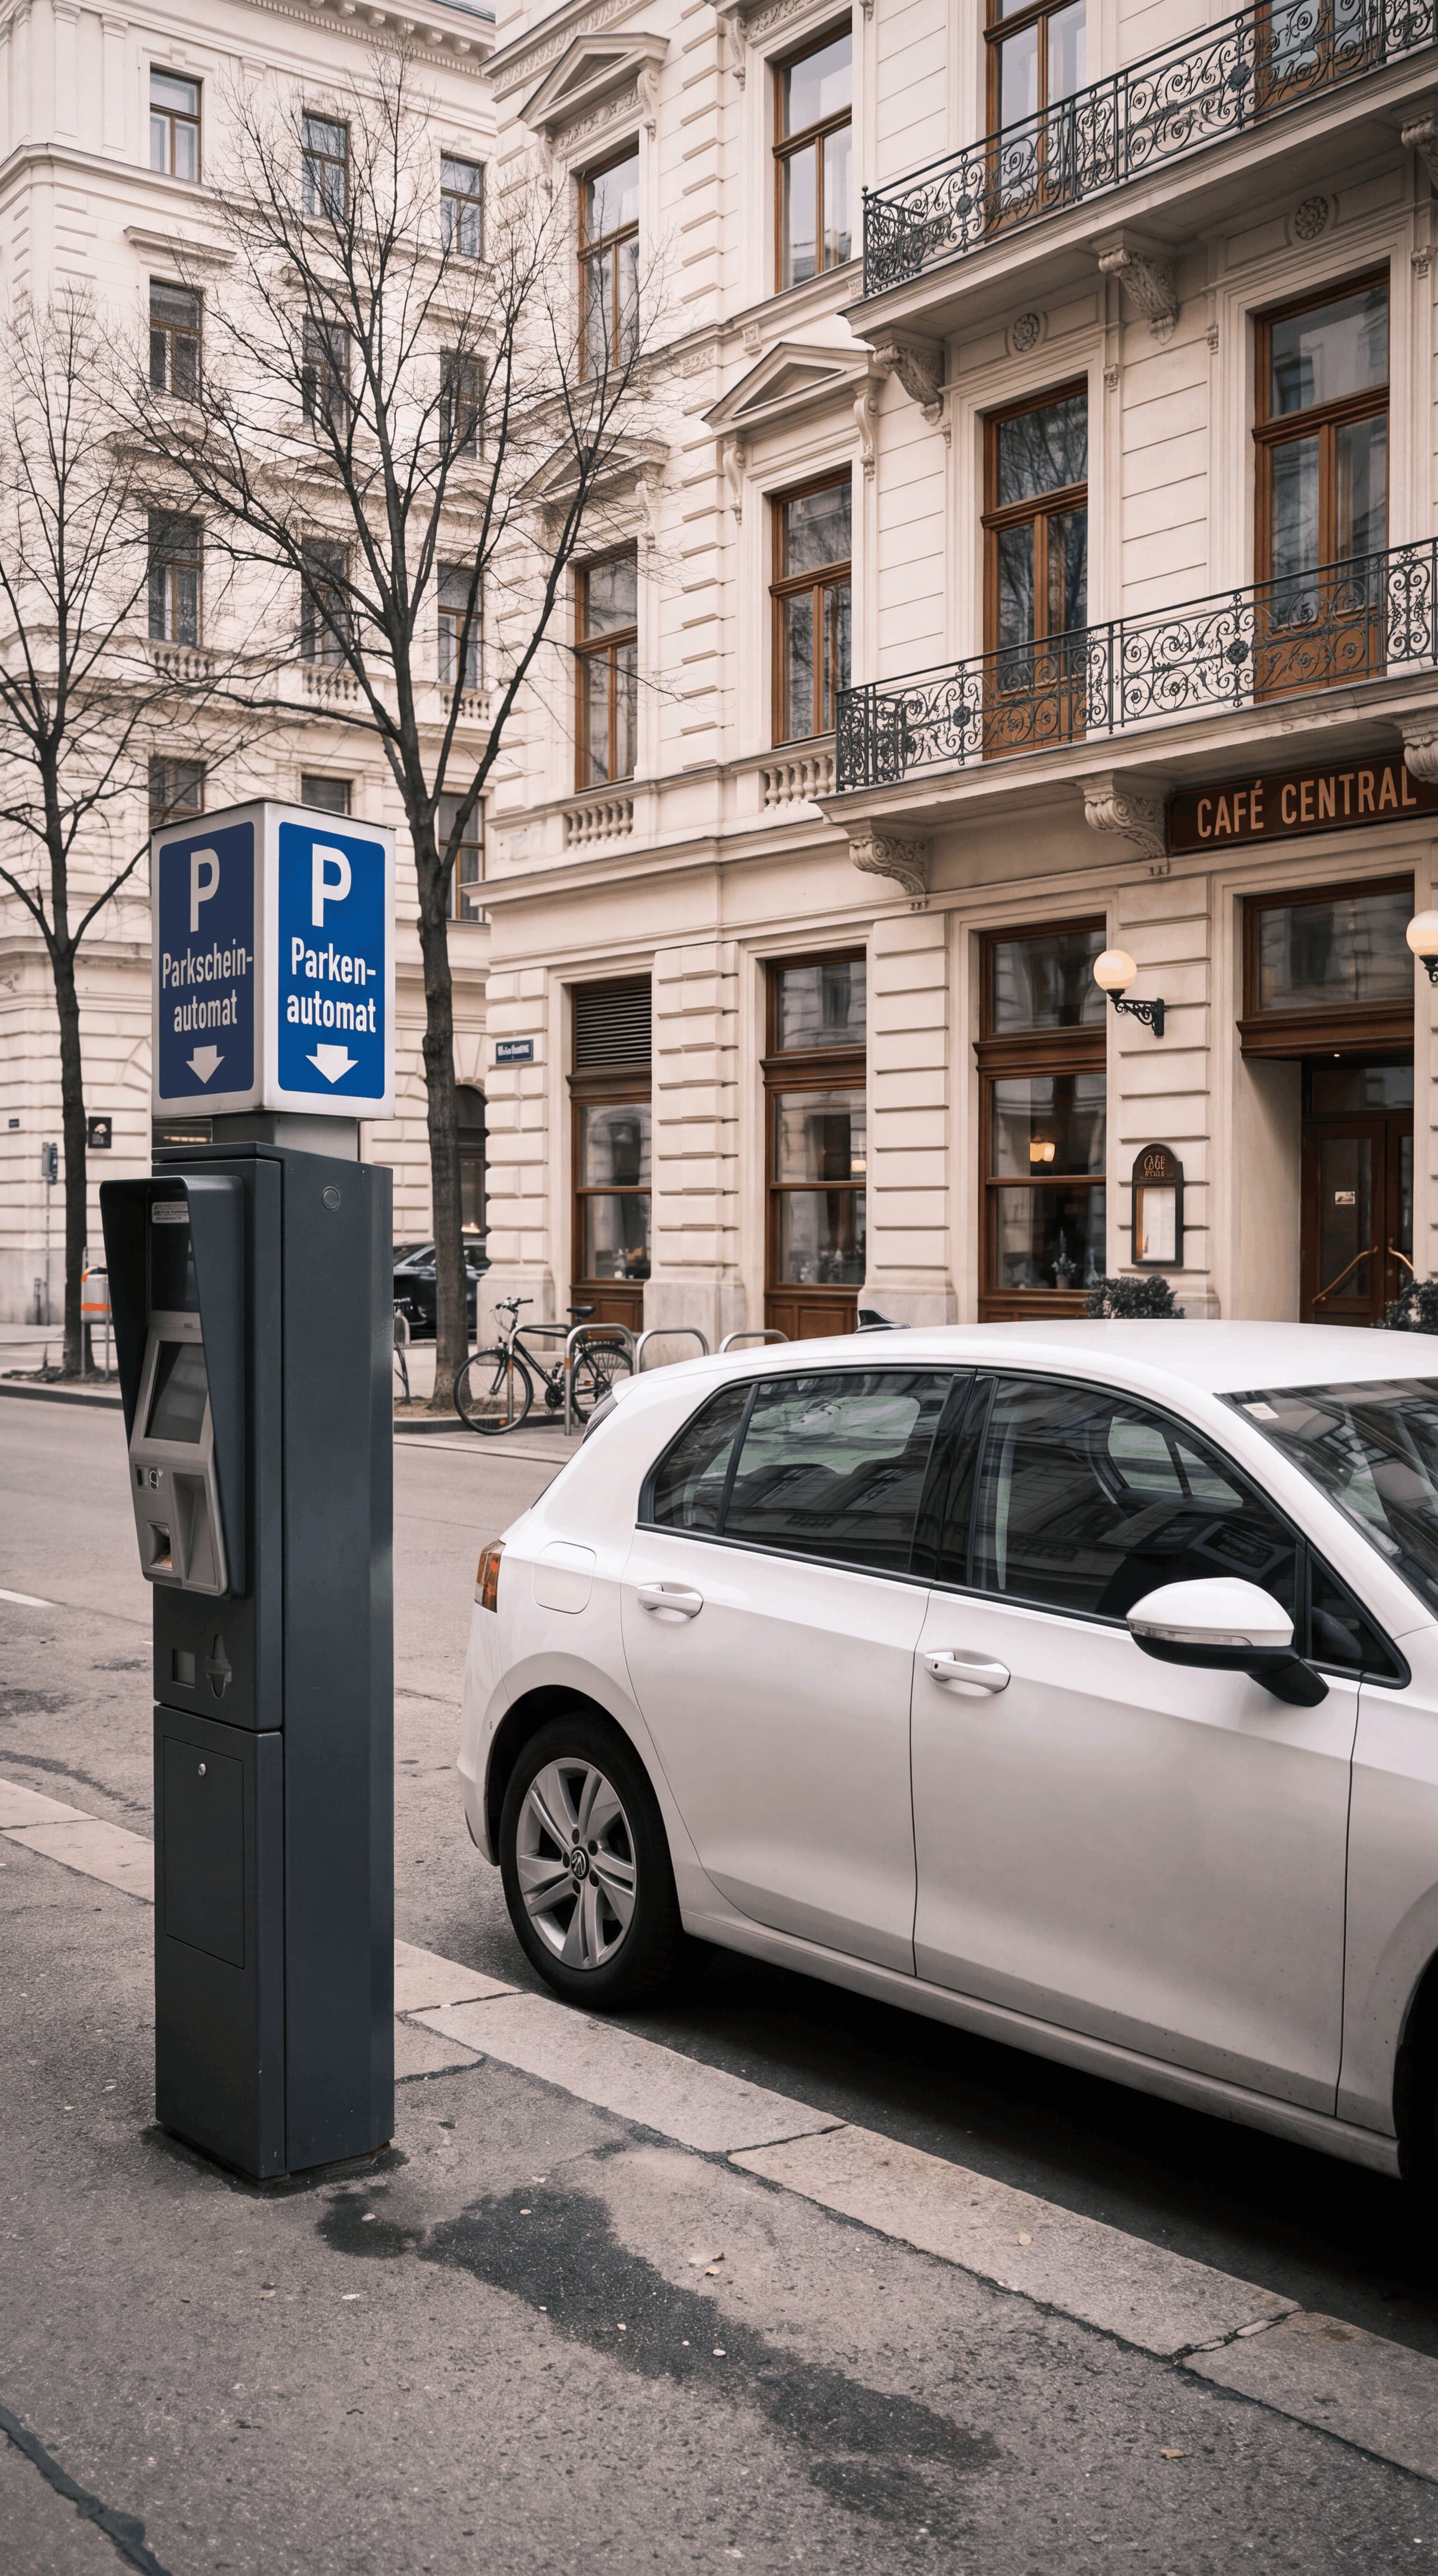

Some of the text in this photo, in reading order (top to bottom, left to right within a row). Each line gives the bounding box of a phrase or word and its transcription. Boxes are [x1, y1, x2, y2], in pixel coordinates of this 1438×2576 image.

[1197, 765, 1416, 838] CAFÉ CENTRAL
[190, 848, 220, 933] P
[312, 843, 352, 927] P
[162, 938, 253, 989] Parkschein-
[292, 937, 376, 985] Parken-
[174, 989, 237, 1032] automat
[287, 990, 376, 1033] automat
